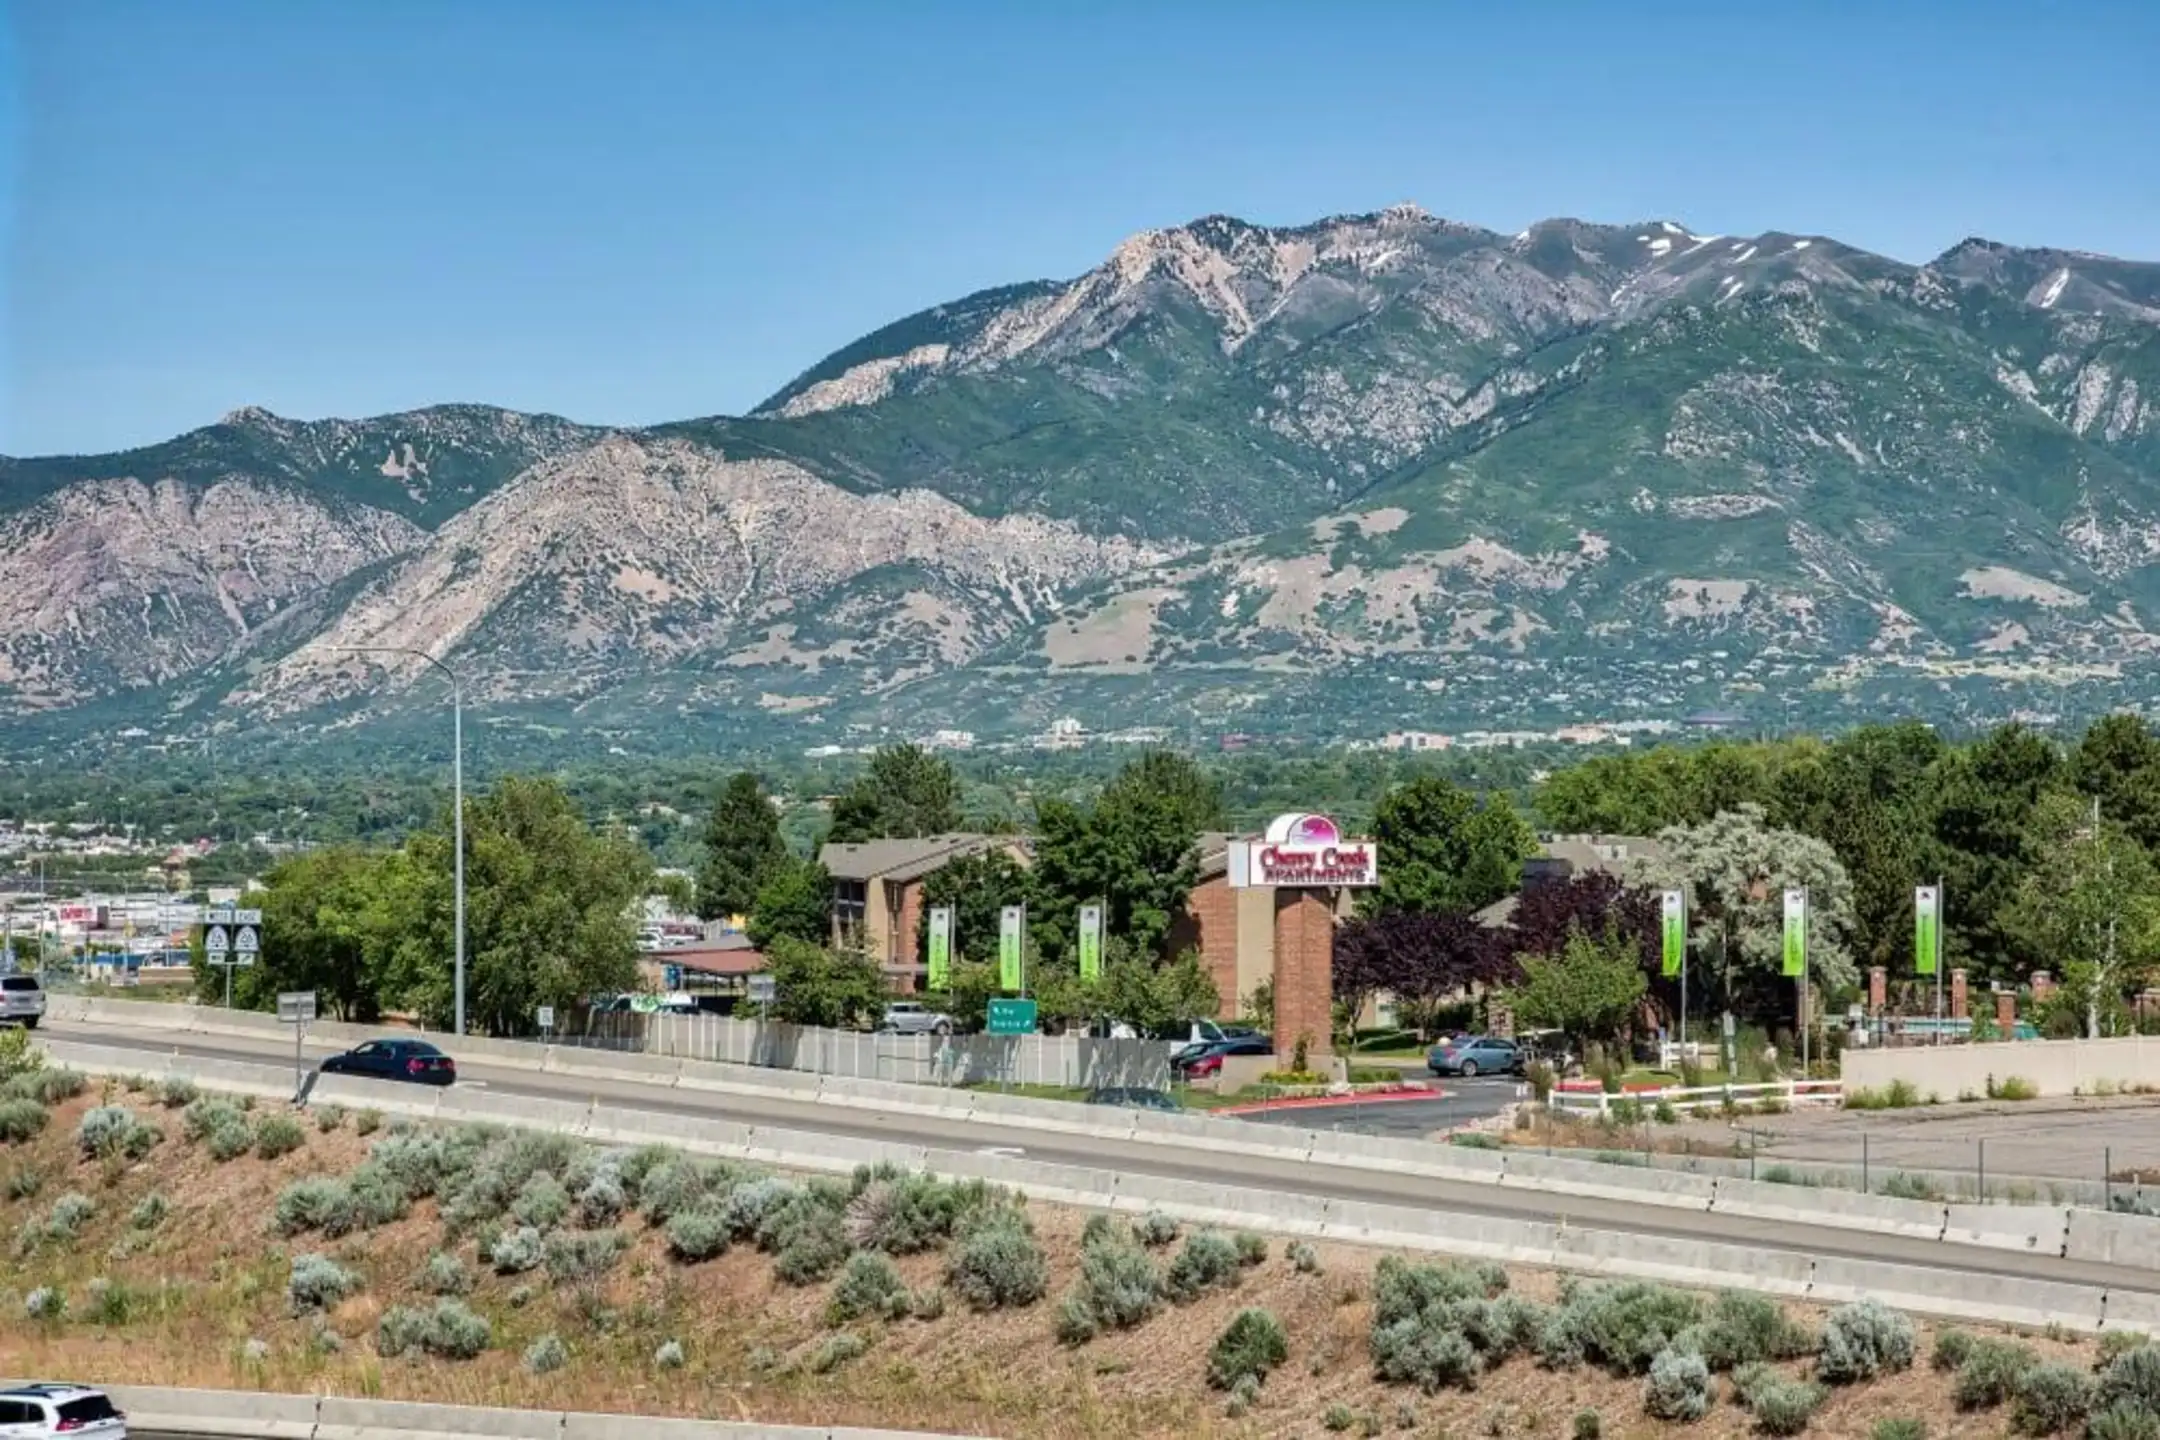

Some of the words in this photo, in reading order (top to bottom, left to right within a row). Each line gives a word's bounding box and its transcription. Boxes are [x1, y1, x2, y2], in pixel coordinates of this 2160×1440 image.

[1259, 844, 1315, 869] Cherry
[1322, 845, 1369, 869] Creek
[1264, 869, 1365, 883] APARTMENTS
